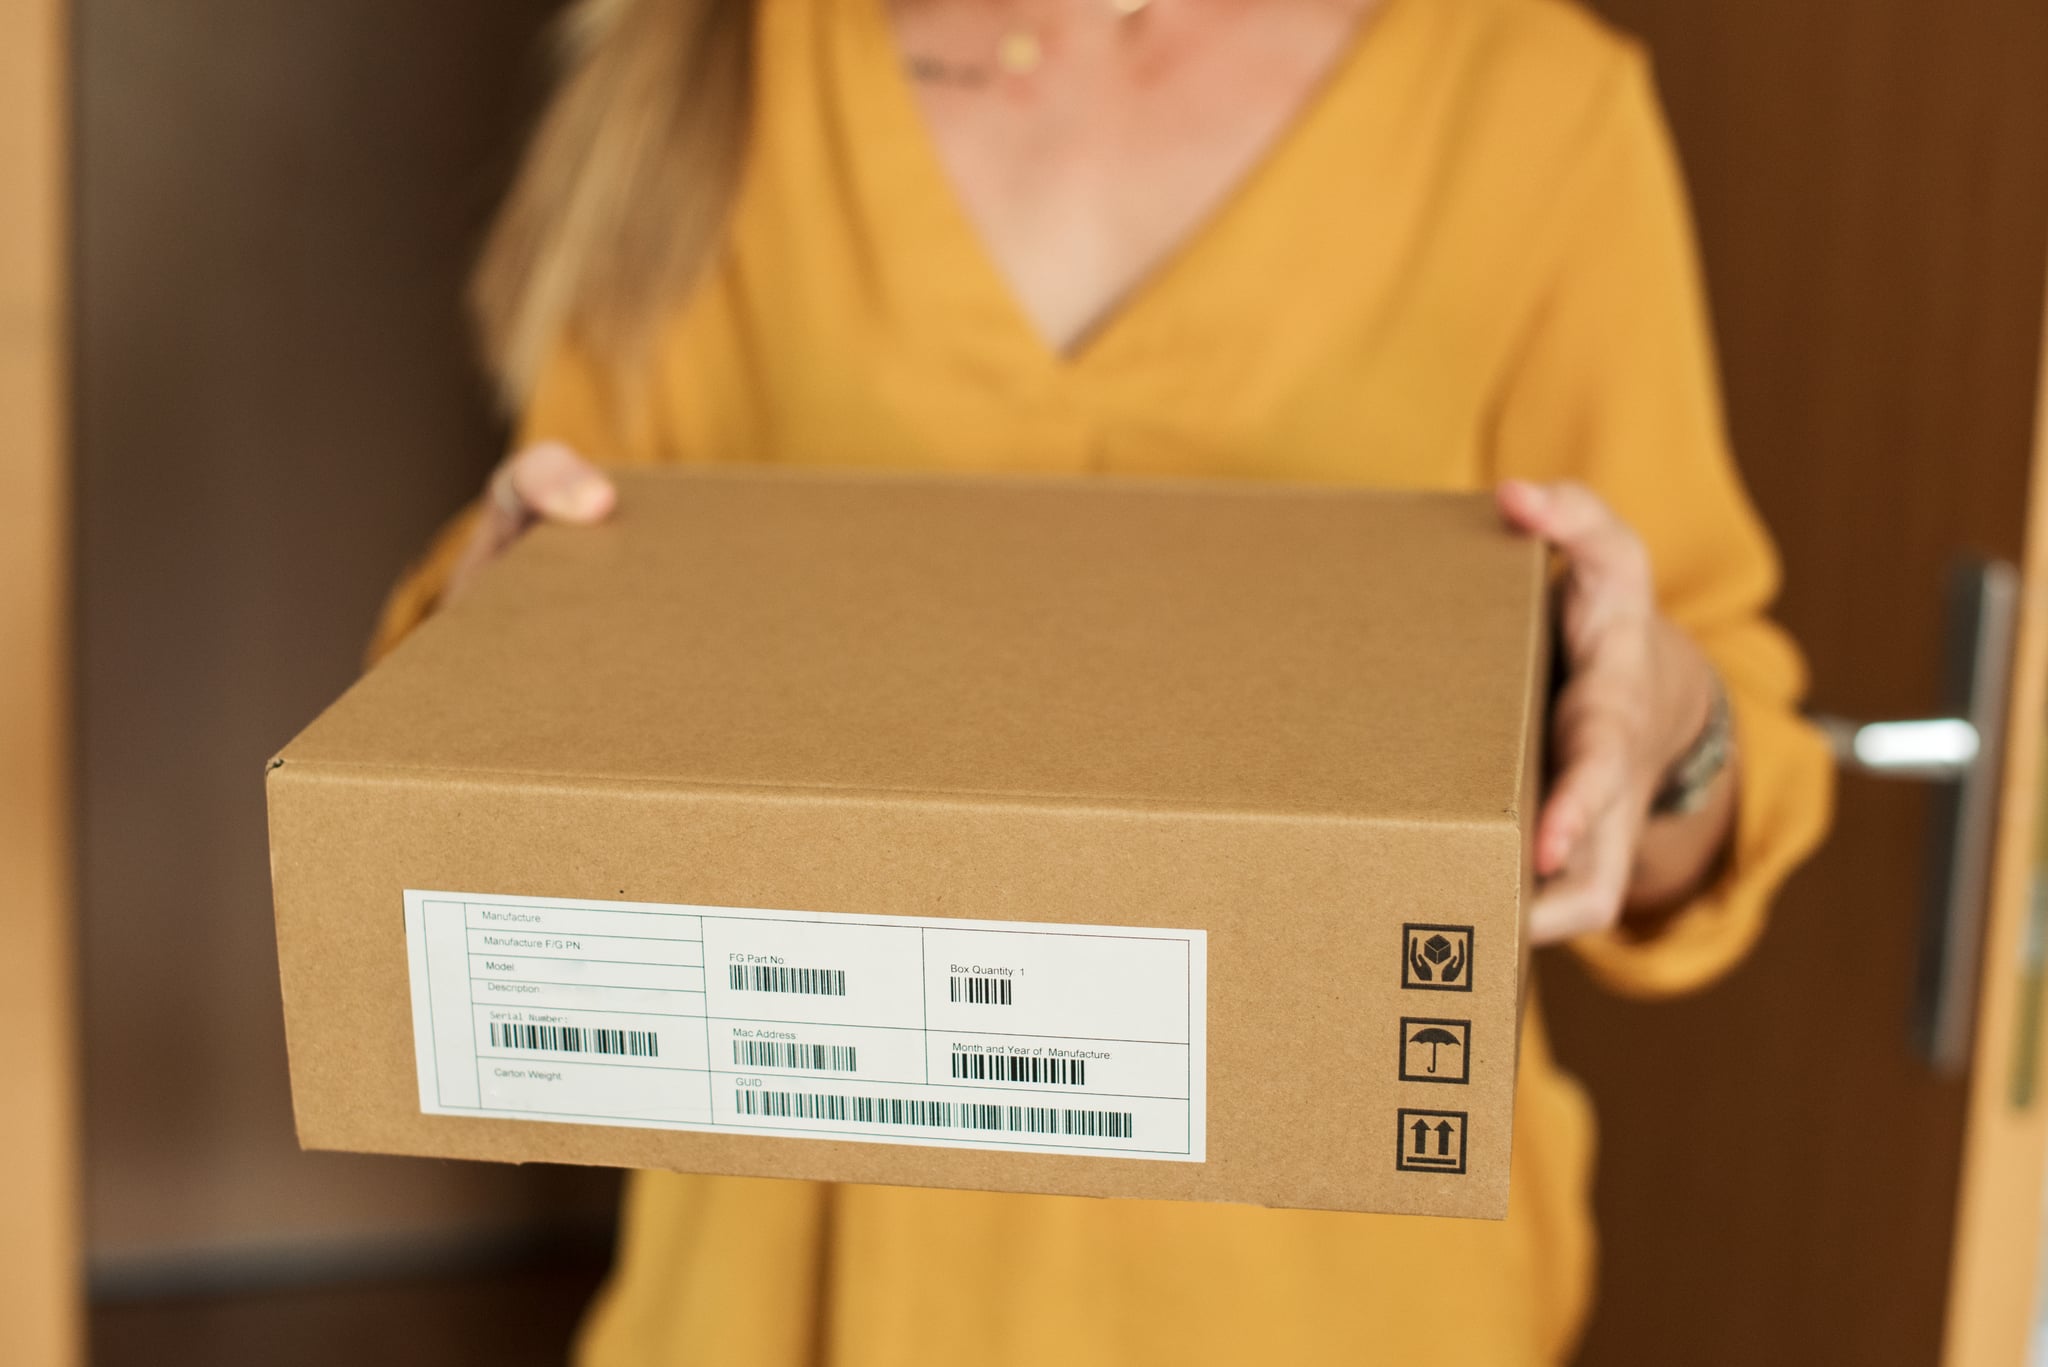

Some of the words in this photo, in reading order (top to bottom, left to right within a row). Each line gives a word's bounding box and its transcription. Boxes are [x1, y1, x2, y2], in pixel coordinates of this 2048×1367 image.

[484, 937, 543, 948] Manufacture
[545, 940, 563, 949] F/G
[729, 953, 744, 963] FG
[747, 954, 767, 964] Part
[950, 964, 969, 973] Box
[1020, 968, 1025, 976] 1
[490, 1011, 523, 1022] Serial
[528, 1014, 569, 1024] Number:
[733, 1028, 753, 1037] Mac
[952, 1043, 983, 1052] Month
[986, 1046, 1005, 1054] and
[1007, 1046, 1030, 1055] Year
[494, 1068, 526, 1078] Carton
[735, 1077, 763, 1087] GUID
